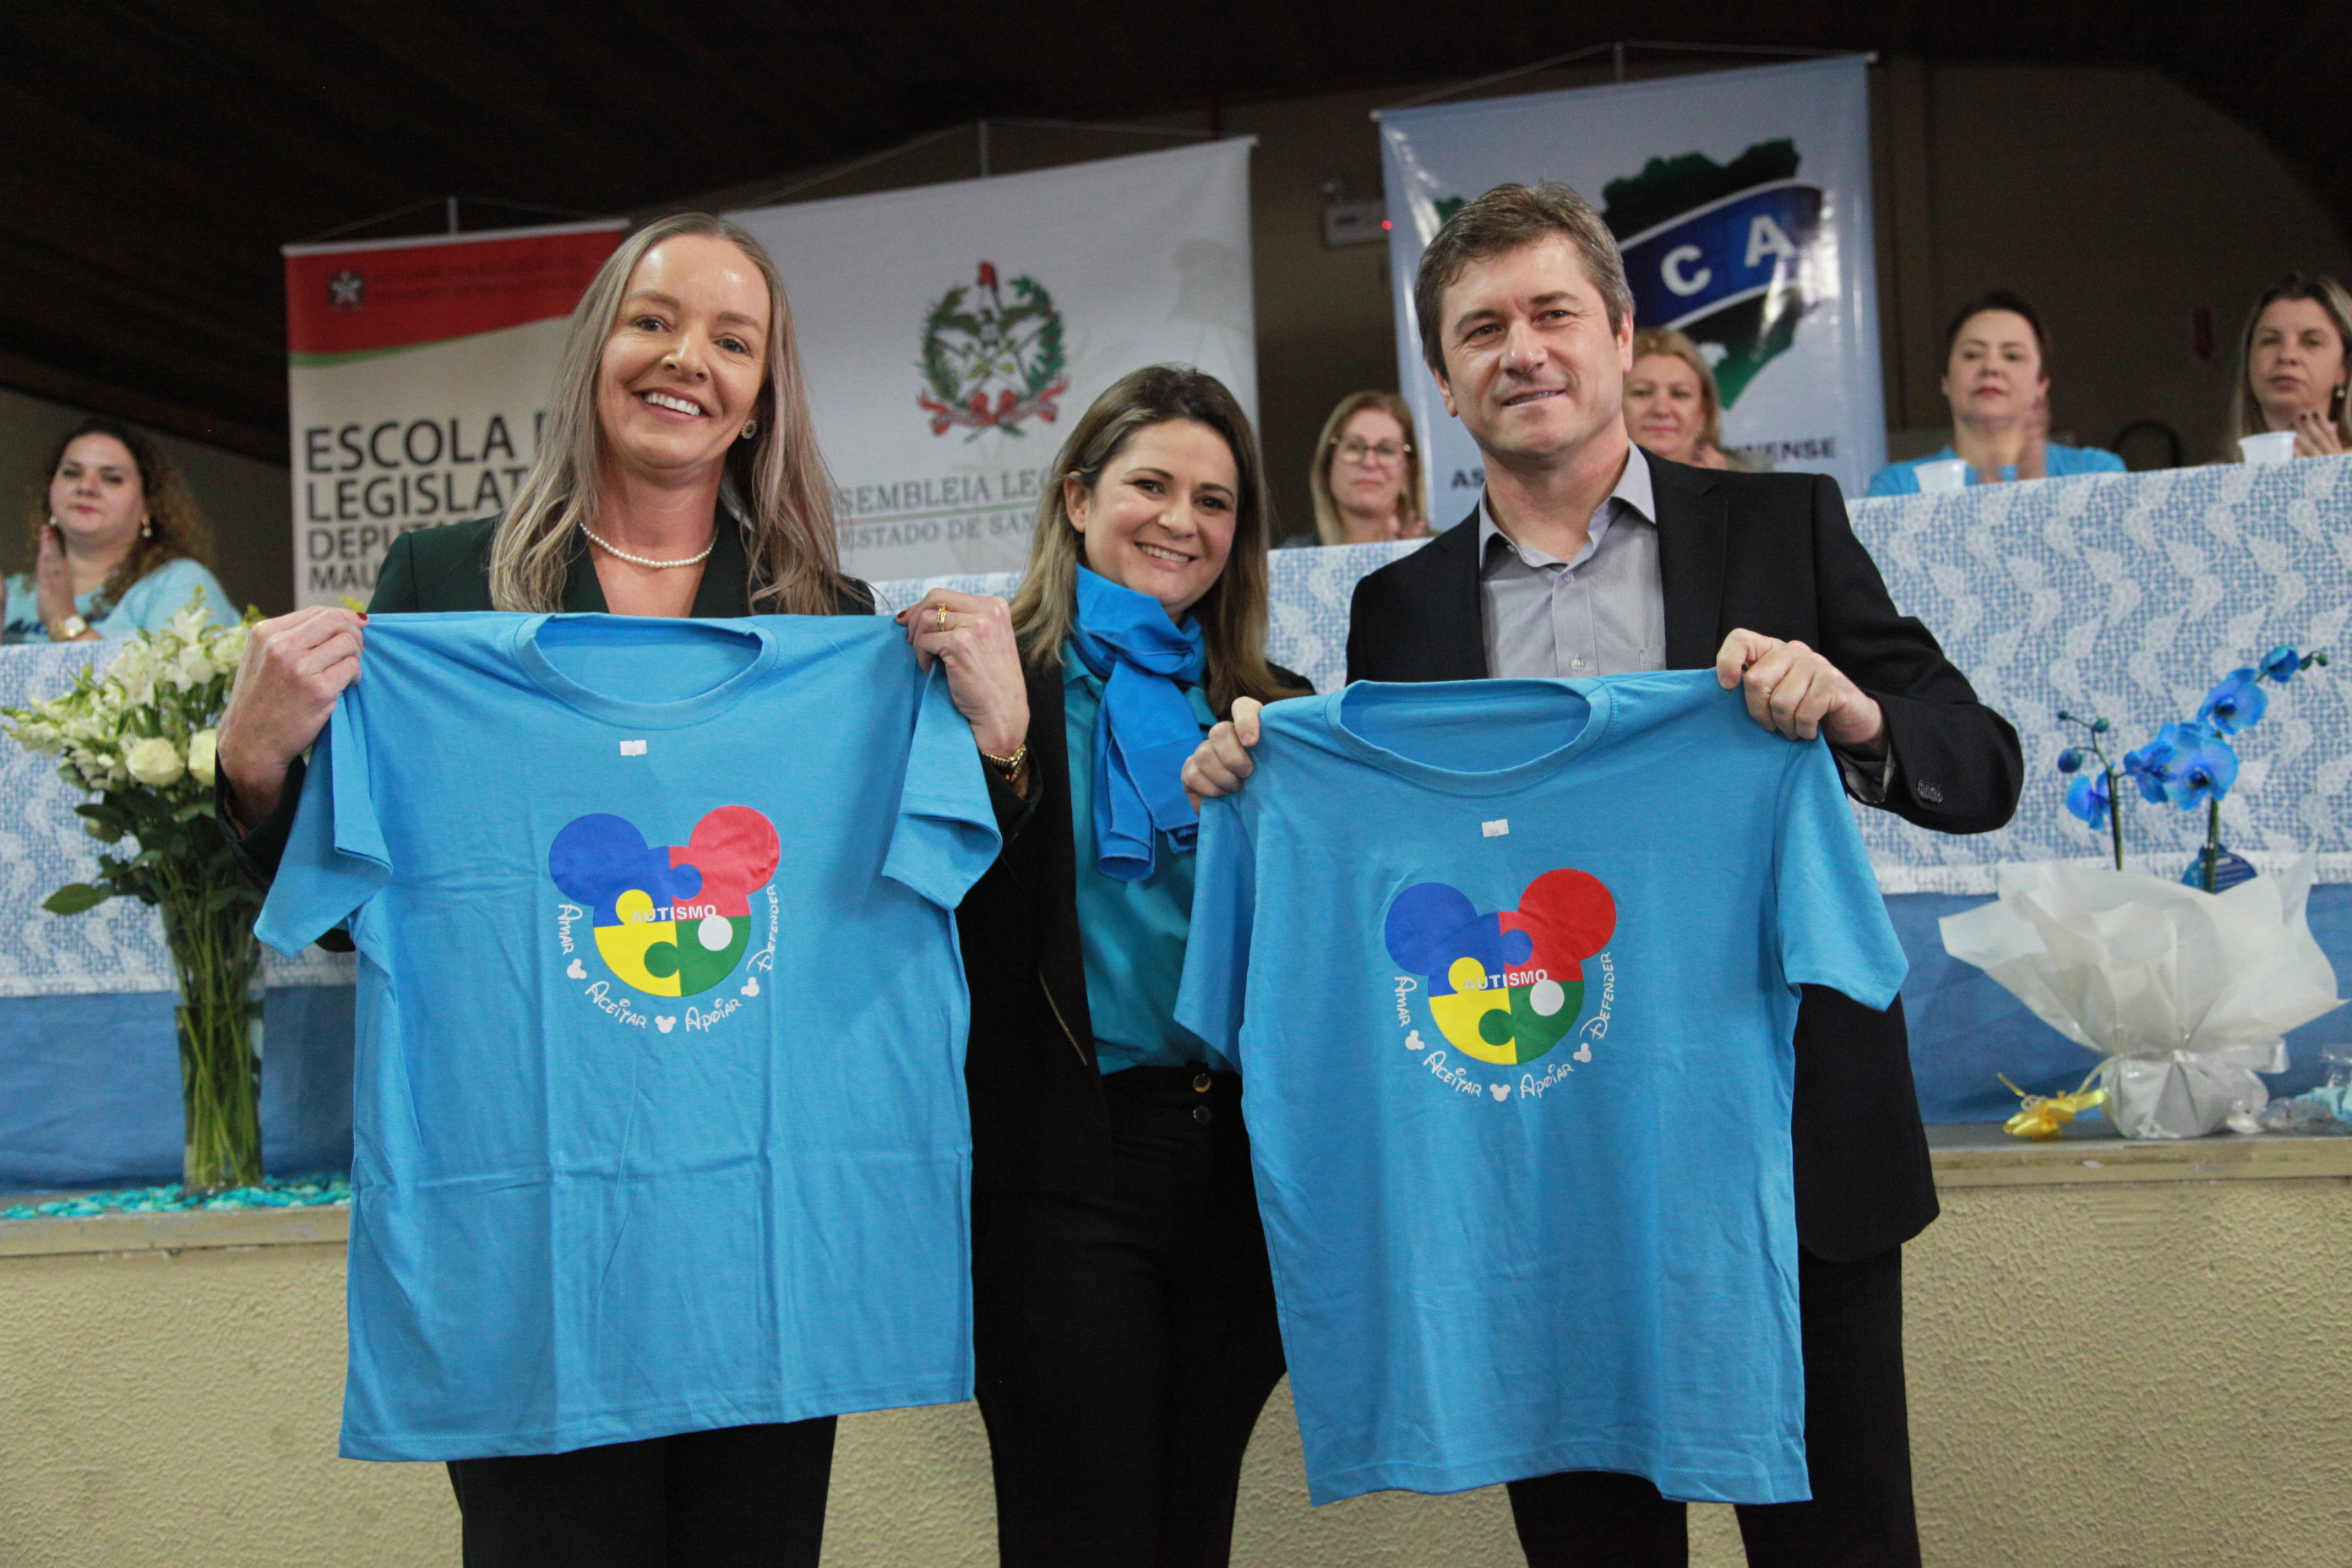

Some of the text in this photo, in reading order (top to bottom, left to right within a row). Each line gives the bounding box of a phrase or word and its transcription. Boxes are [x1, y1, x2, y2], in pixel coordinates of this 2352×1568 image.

[1661, 214, 1796, 297] C A
[305, 416, 514, 473] ESCOLA
[947, 515, 982, 542] DE
[630, 904, 716, 923] AUTISMO
[1464, 969, 1548, 991] AUTISMO
